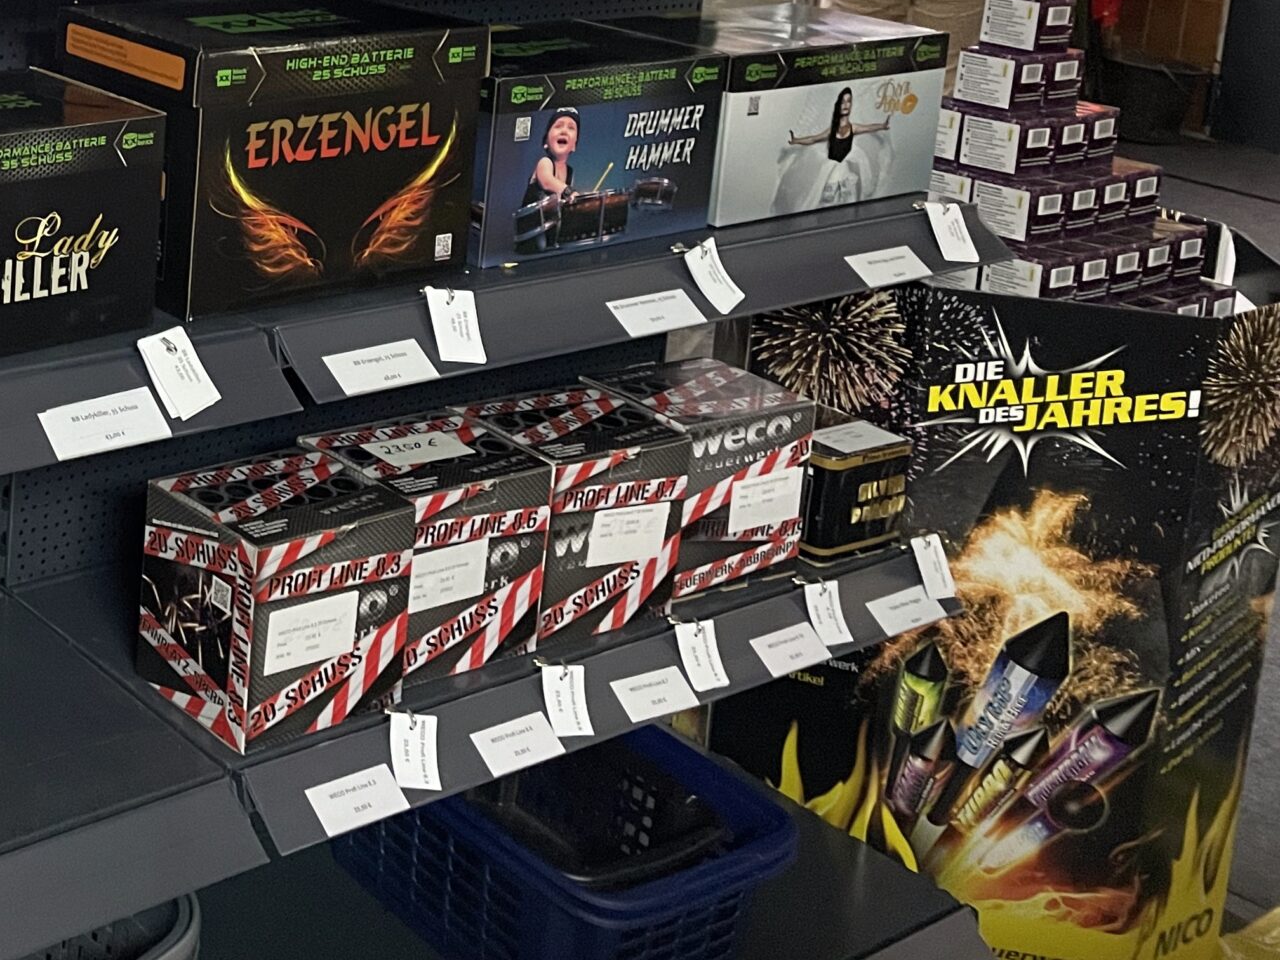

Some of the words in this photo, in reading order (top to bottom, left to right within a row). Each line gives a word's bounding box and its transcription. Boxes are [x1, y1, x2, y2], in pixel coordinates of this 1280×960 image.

[286, 55, 348, 71] HIGH-END
[351, 48, 414, 64] BATTERIE
[312, 70, 330, 81] 25
[333, 64, 386, 78] SCHUSS
[245, 102, 441, 169] ERZENGEL
[624, 103, 706, 139] DRUMMER
[1, 160, 19, 170] 35
[21, 152, 73, 168] SCHUSS
[57, 136, 107, 152] BATTERIE
[625, 137, 697, 172] HAMMER
[15, 211, 119, 270] Lady
[926, 369, 1126, 414] KNALLER
[954, 360, 1005, 384] DIE
[978, 405, 1024, 425] DES
[1013, 390, 1202, 432] JAHRES!
[691, 414, 792, 459] weco
[563, 486, 610, 509] PROFI
[616, 483, 650, 505] LINE
[414, 521, 464, 545] PROFI
[470, 514, 507, 538] LINE
[148, 531, 238, 572] 20-SCHUSS
[268, 567, 323, 598] PROFI
[330, 560, 369, 586] LINE
[542, 561, 641, 630] 20-SCHUSS
[406, 597, 499, 667] 0-SCHUSS
[249, 643, 363, 731] 20-SCHUSS
[1154, 907, 1215, 960] NICO
